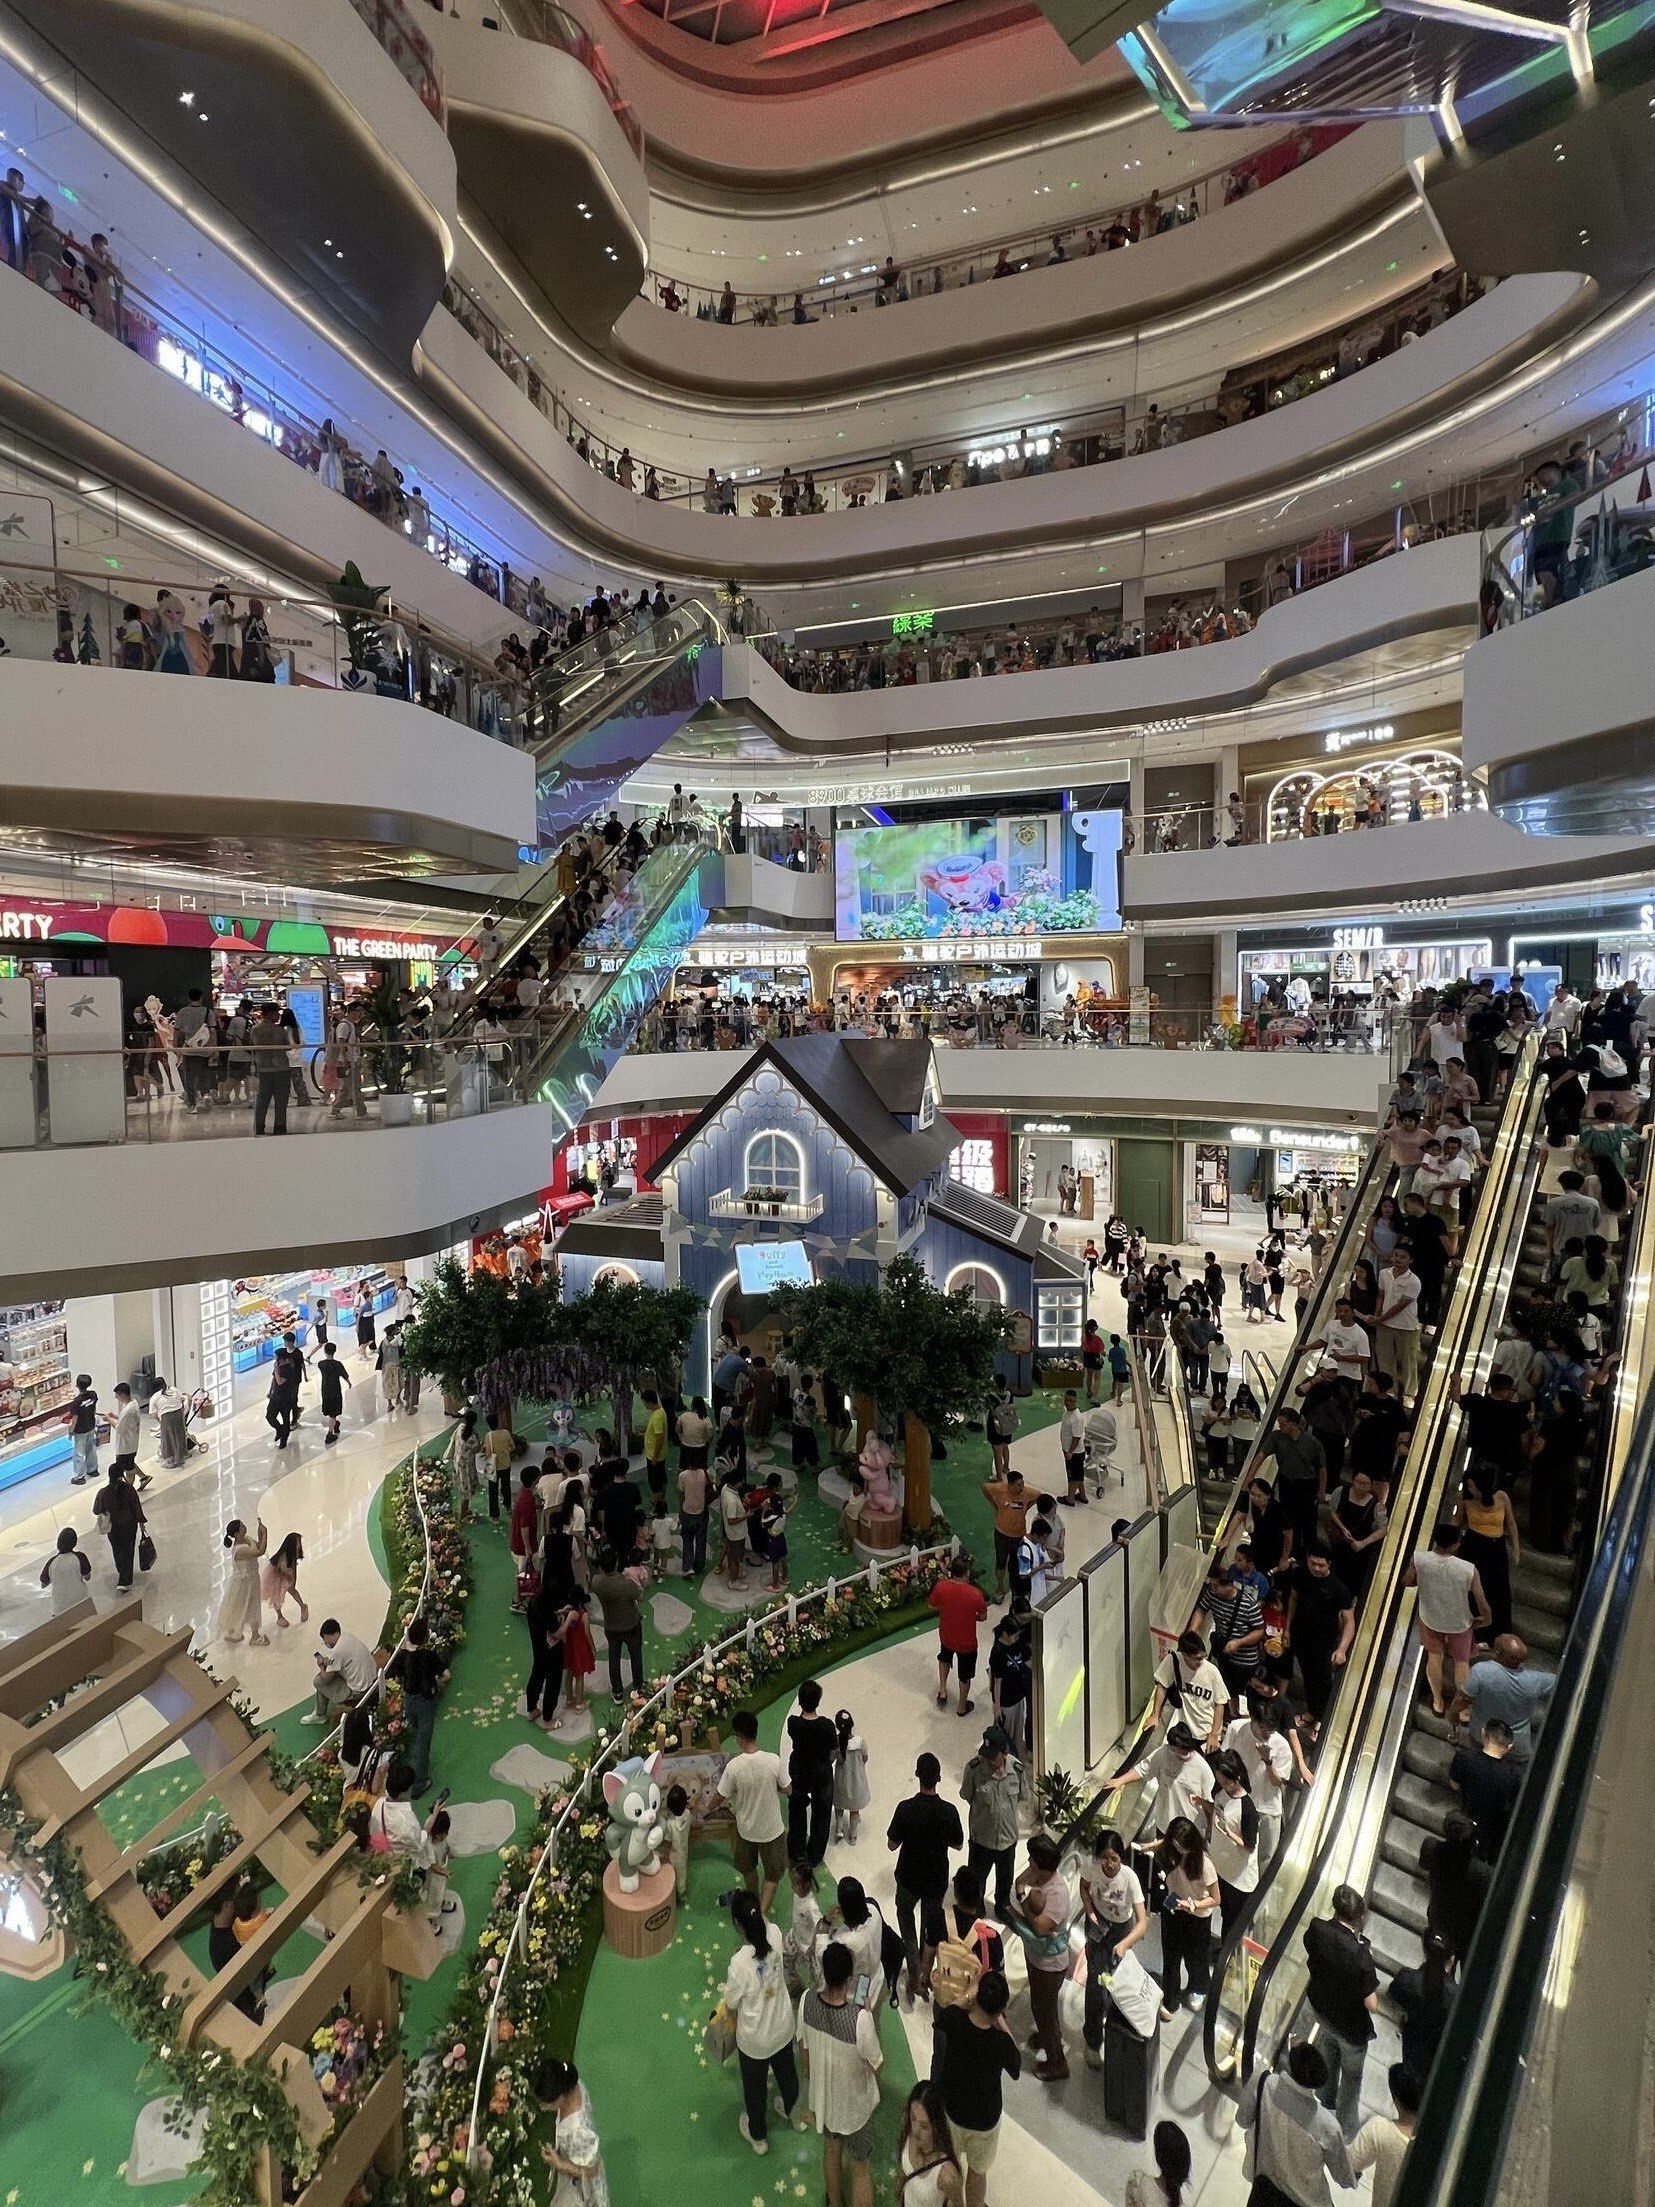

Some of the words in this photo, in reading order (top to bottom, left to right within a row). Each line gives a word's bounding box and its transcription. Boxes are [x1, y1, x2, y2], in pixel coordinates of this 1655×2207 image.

[0, 911, 54, 940] RTY
[333, 936, 361, 957] THE
[361, 938, 402, 959] GREEN
[402, 943, 438, 960] PARTY
